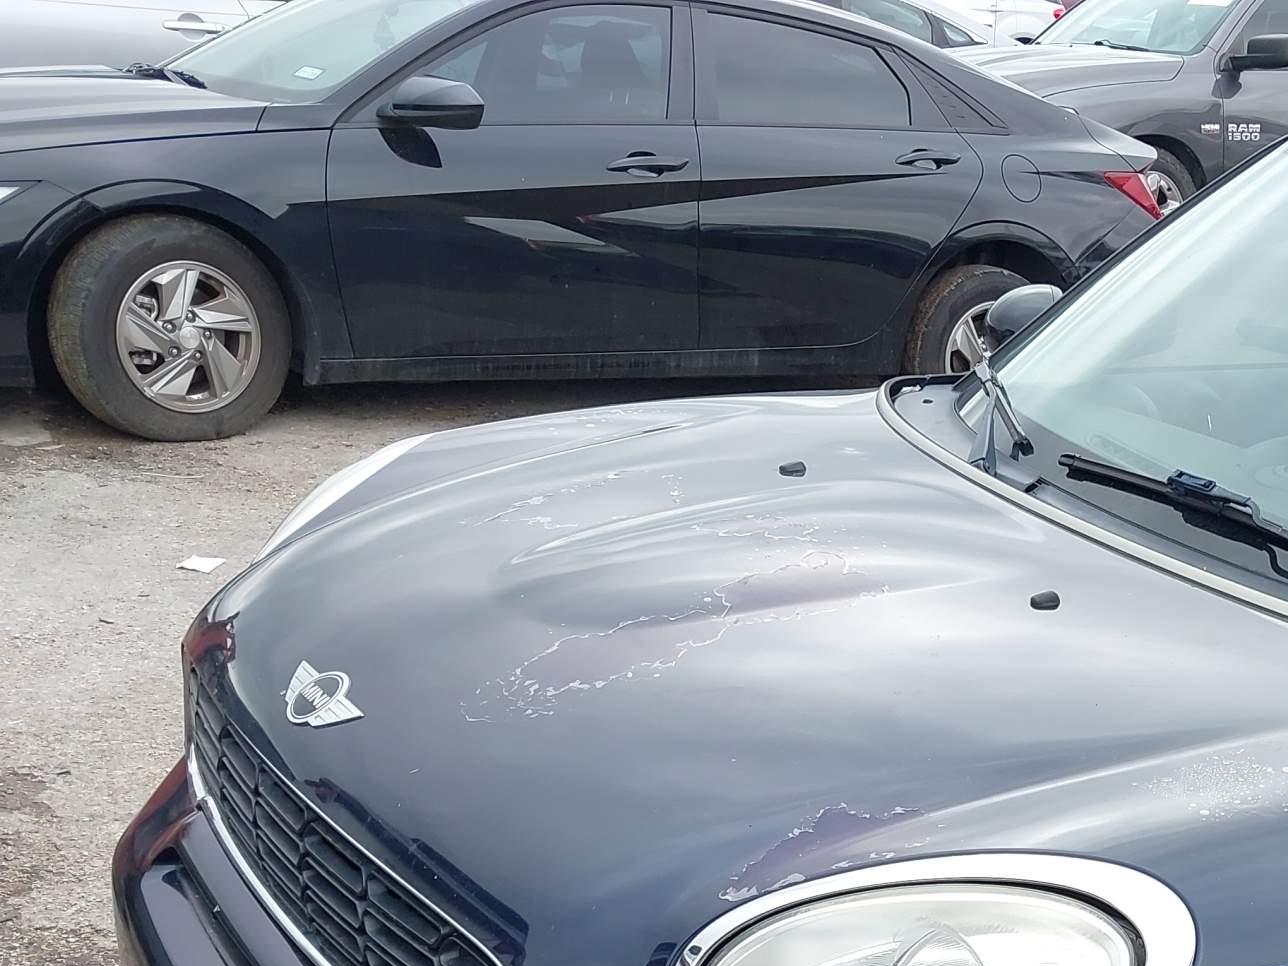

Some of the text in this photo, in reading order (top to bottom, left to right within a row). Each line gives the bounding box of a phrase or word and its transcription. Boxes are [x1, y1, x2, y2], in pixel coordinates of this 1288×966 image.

[1228, 123, 1260, 132] RAM
[1228, 132, 1260, 141] 1500
[301, 682, 330, 709] MINI
